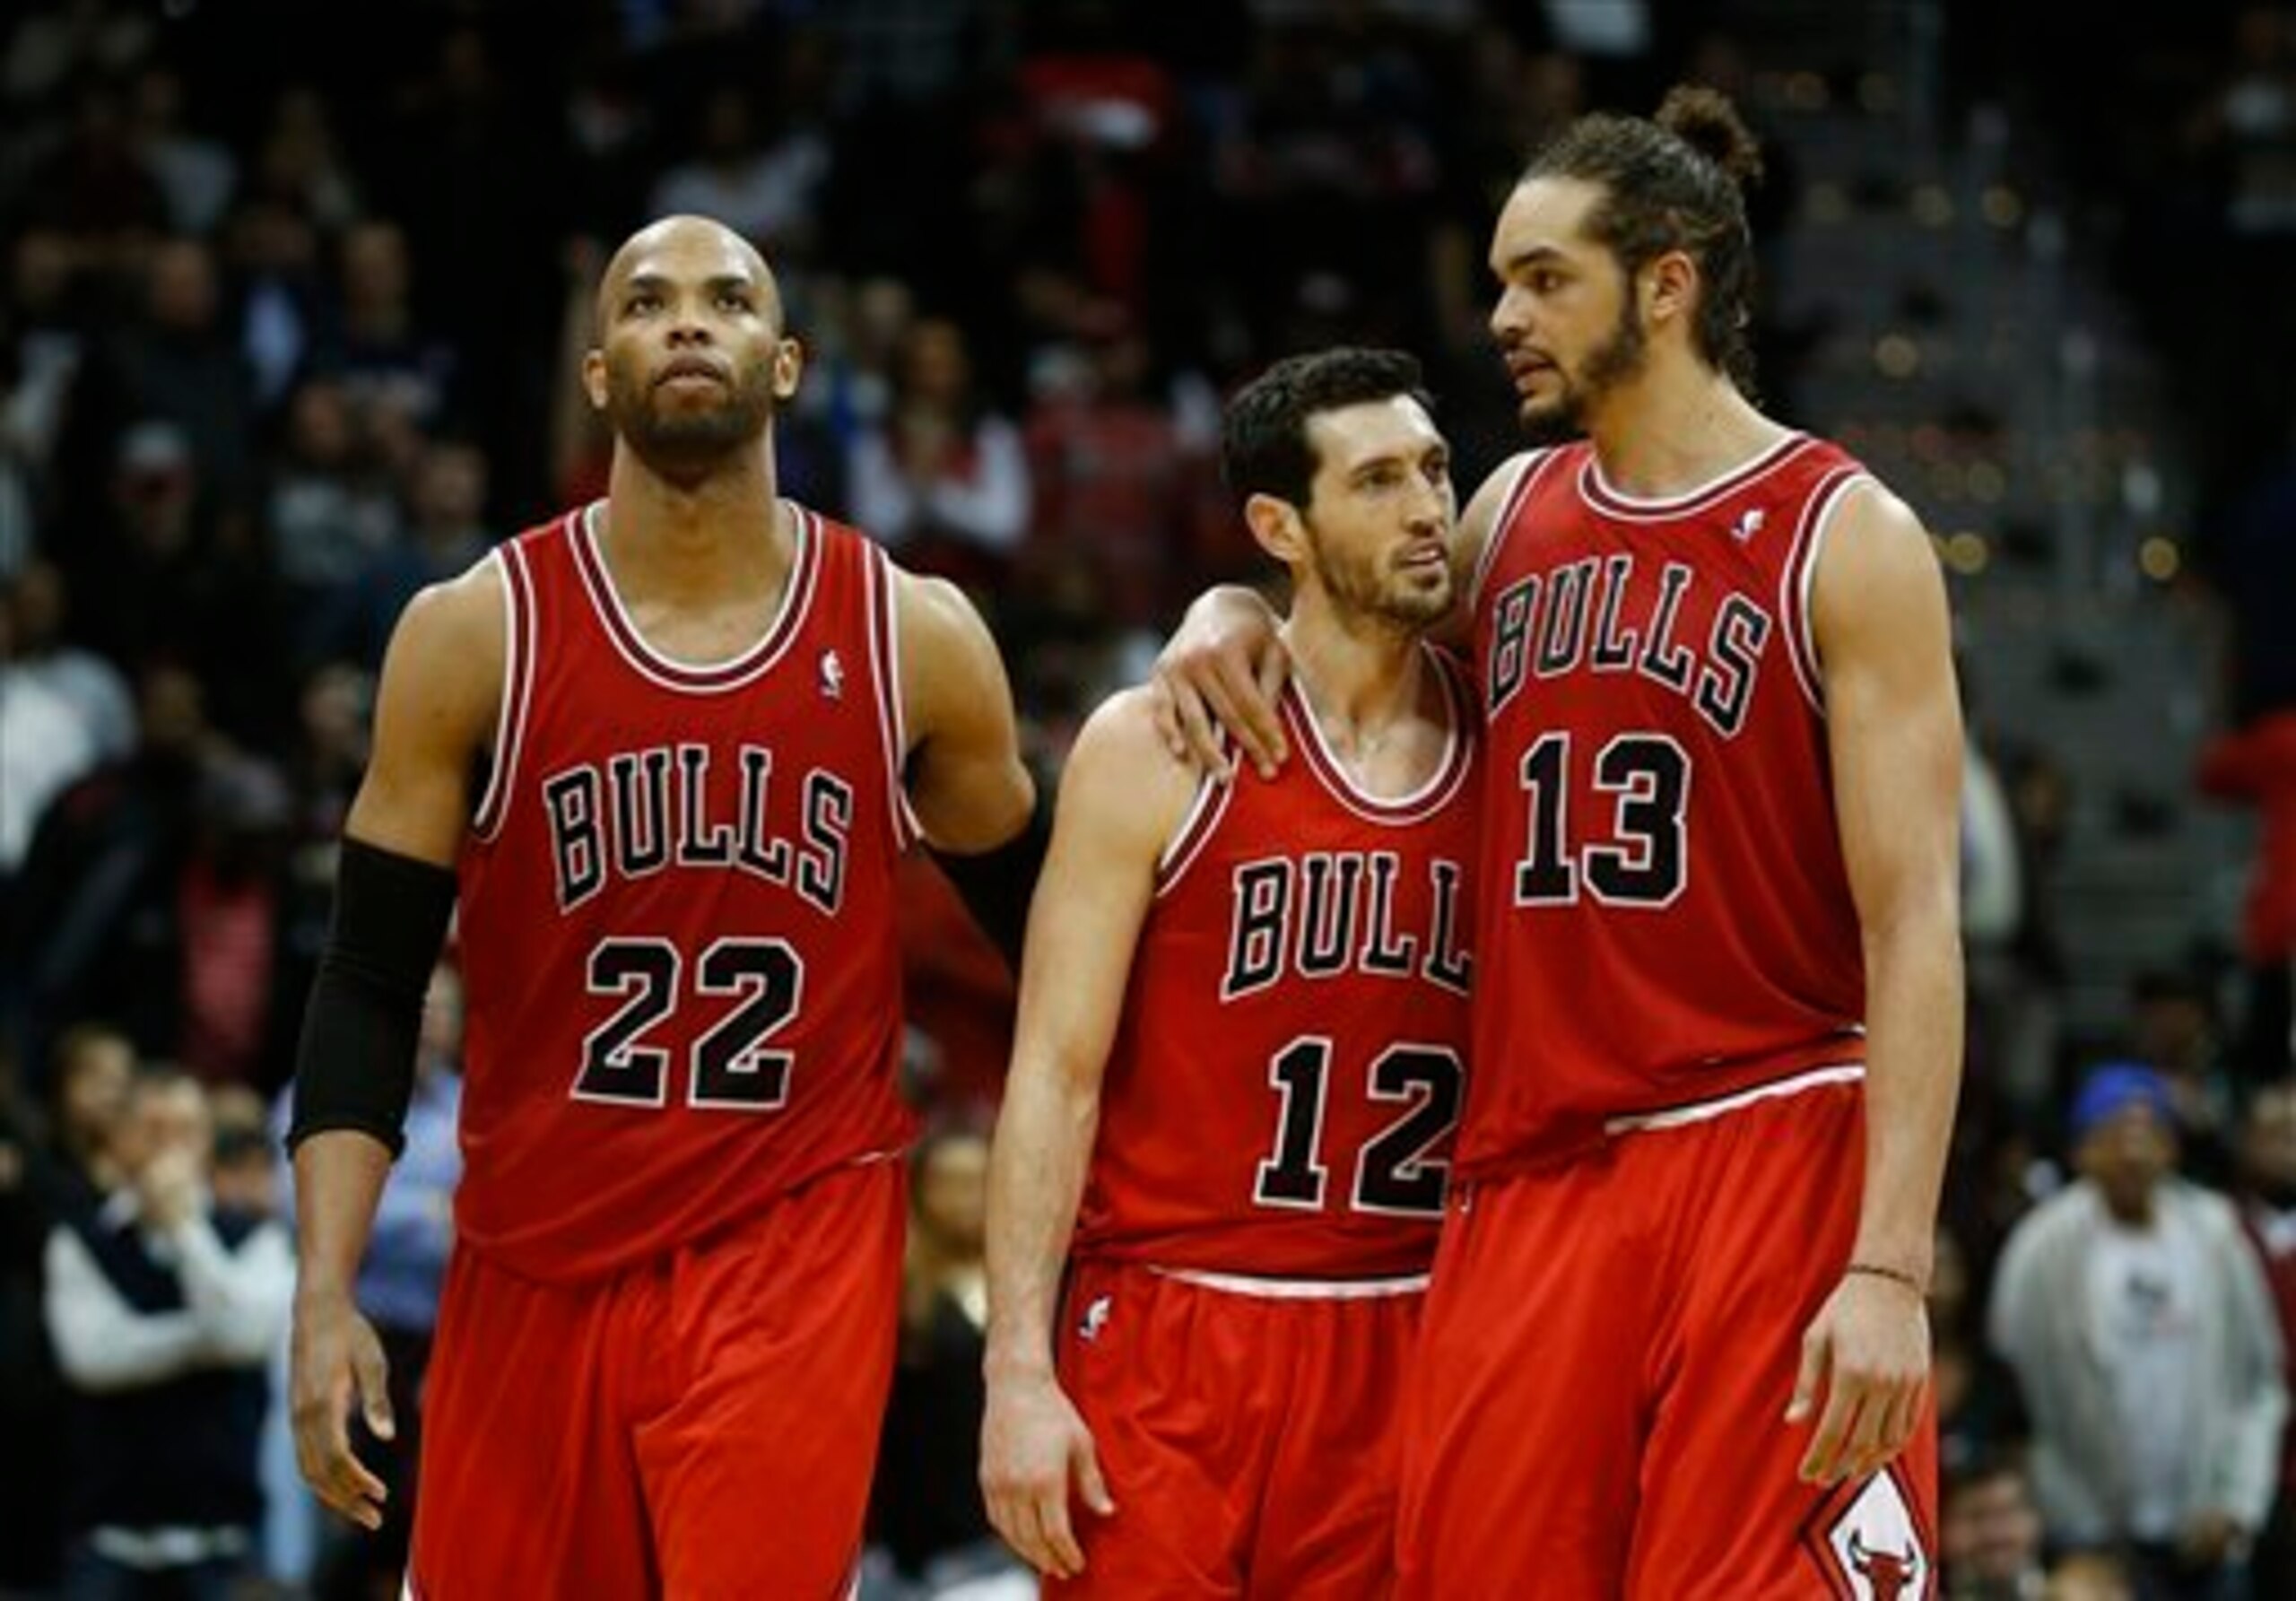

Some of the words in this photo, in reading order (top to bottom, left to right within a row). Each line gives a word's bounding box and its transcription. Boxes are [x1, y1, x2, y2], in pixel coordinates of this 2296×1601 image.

[1489, 553, 1772, 739] BULLS
[544, 744, 853, 917] BULLS
[1515, 731, 1692, 909] 13
[569, 936, 803, 1109] 22
[1254, 1036, 1465, 1217] 12
